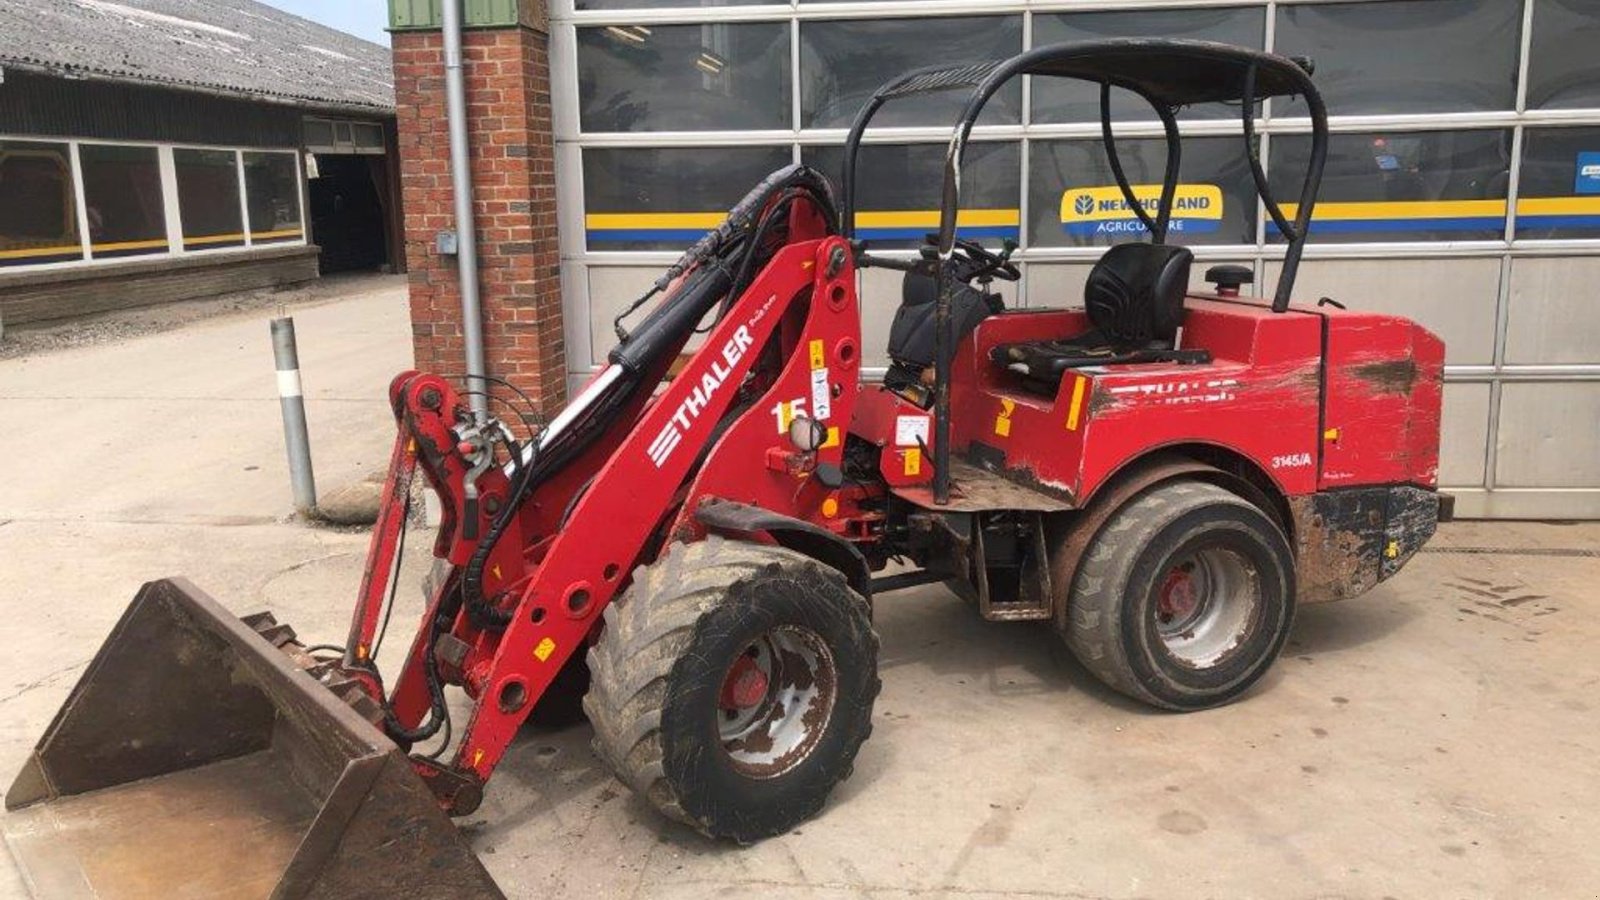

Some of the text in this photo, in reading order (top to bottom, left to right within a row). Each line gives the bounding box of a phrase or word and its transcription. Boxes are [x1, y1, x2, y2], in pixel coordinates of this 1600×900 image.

[1138, 197, 1210, 210] HOAND
[1097, 220, 1184, 232] AGRICURE
[671, 324, 754, 430] THALER
[1272, 453, 1312, 469] 3145/A
